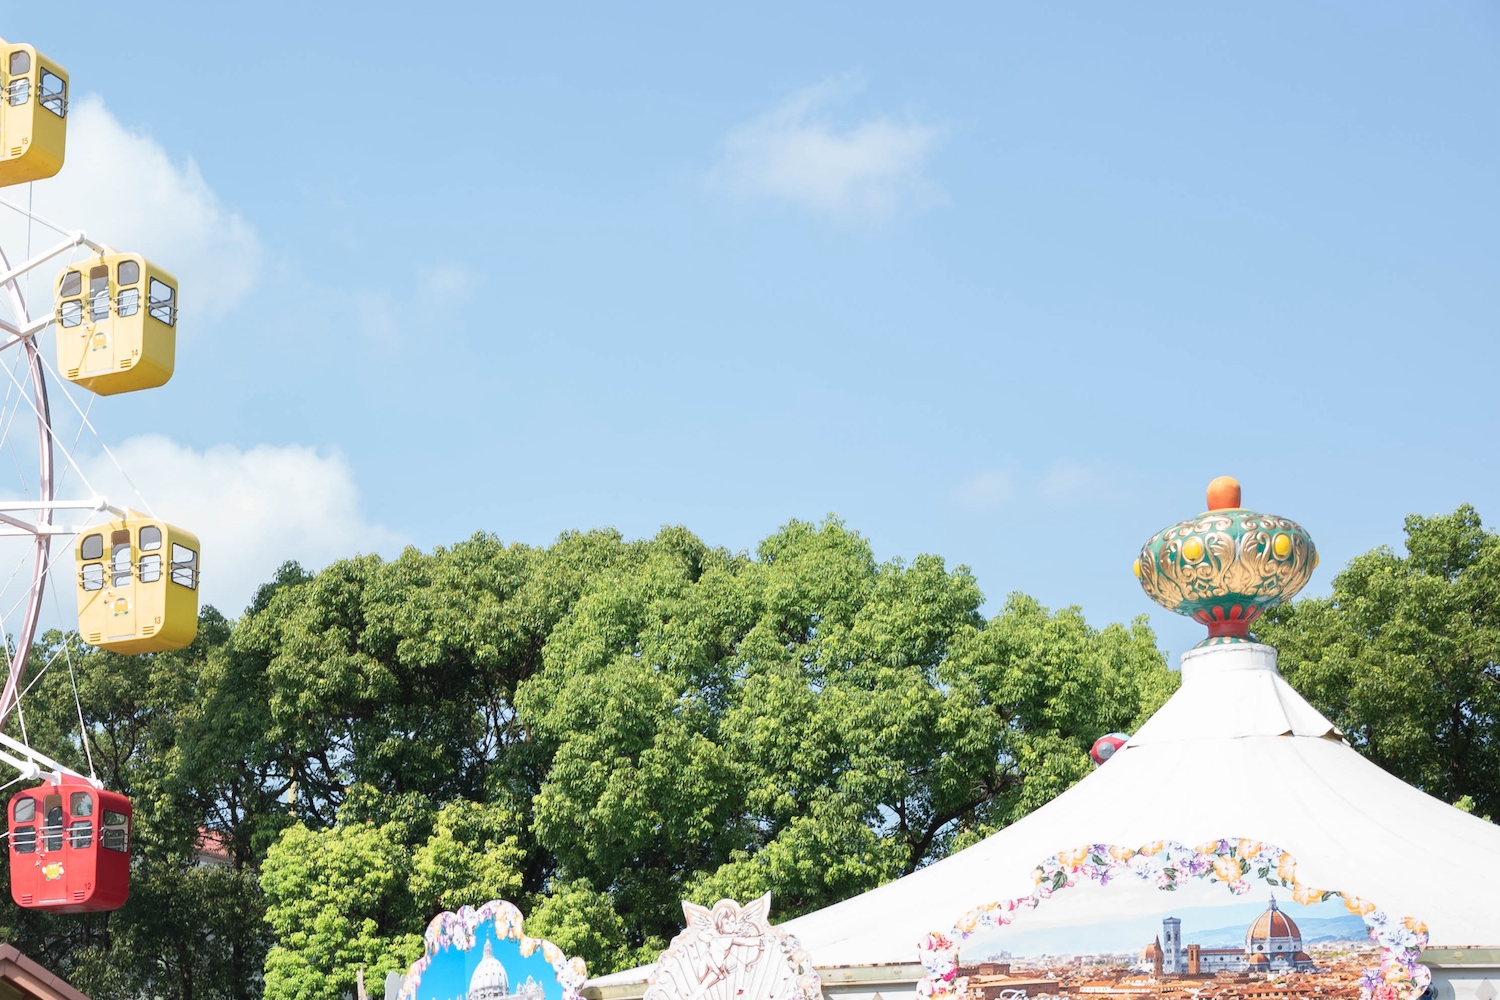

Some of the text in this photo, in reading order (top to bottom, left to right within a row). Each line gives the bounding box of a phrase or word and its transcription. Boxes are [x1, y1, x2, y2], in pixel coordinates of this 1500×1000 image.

[21, 136, 29, 145] 15
[154, 616, 161, 625] 13
[84, 882, 92, 890] 12
